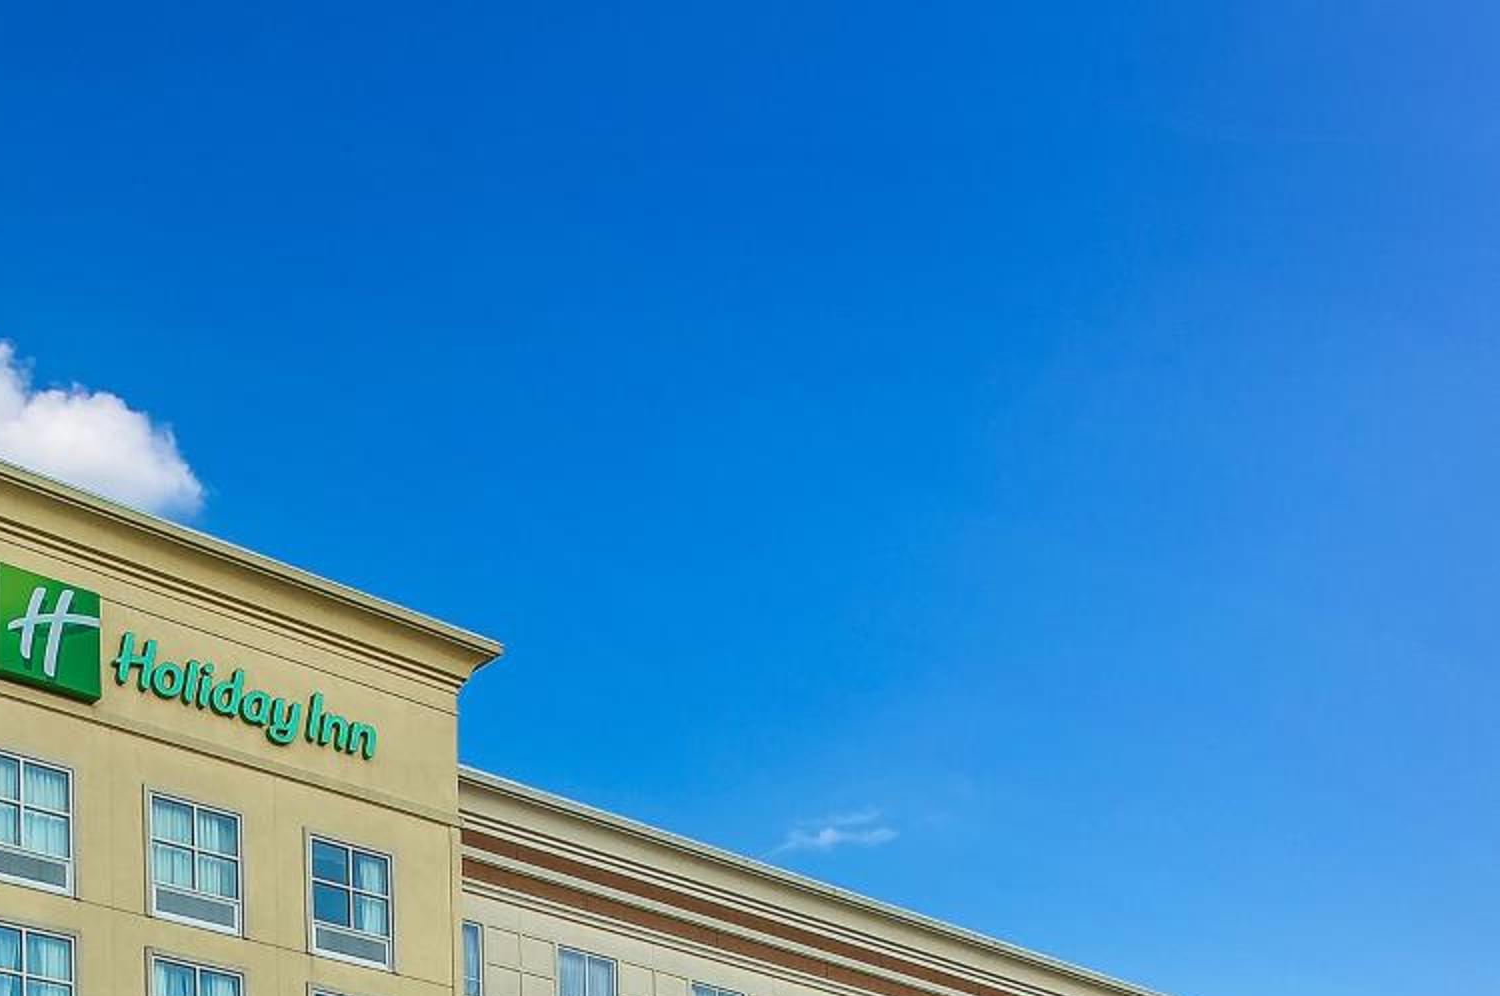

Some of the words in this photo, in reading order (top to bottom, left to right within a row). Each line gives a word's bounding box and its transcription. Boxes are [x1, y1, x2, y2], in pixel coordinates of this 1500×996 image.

[7, 586, 100, 677] H
[112, 631, 301, 744] Holiday
[307, 692, 378, 760] Inn
